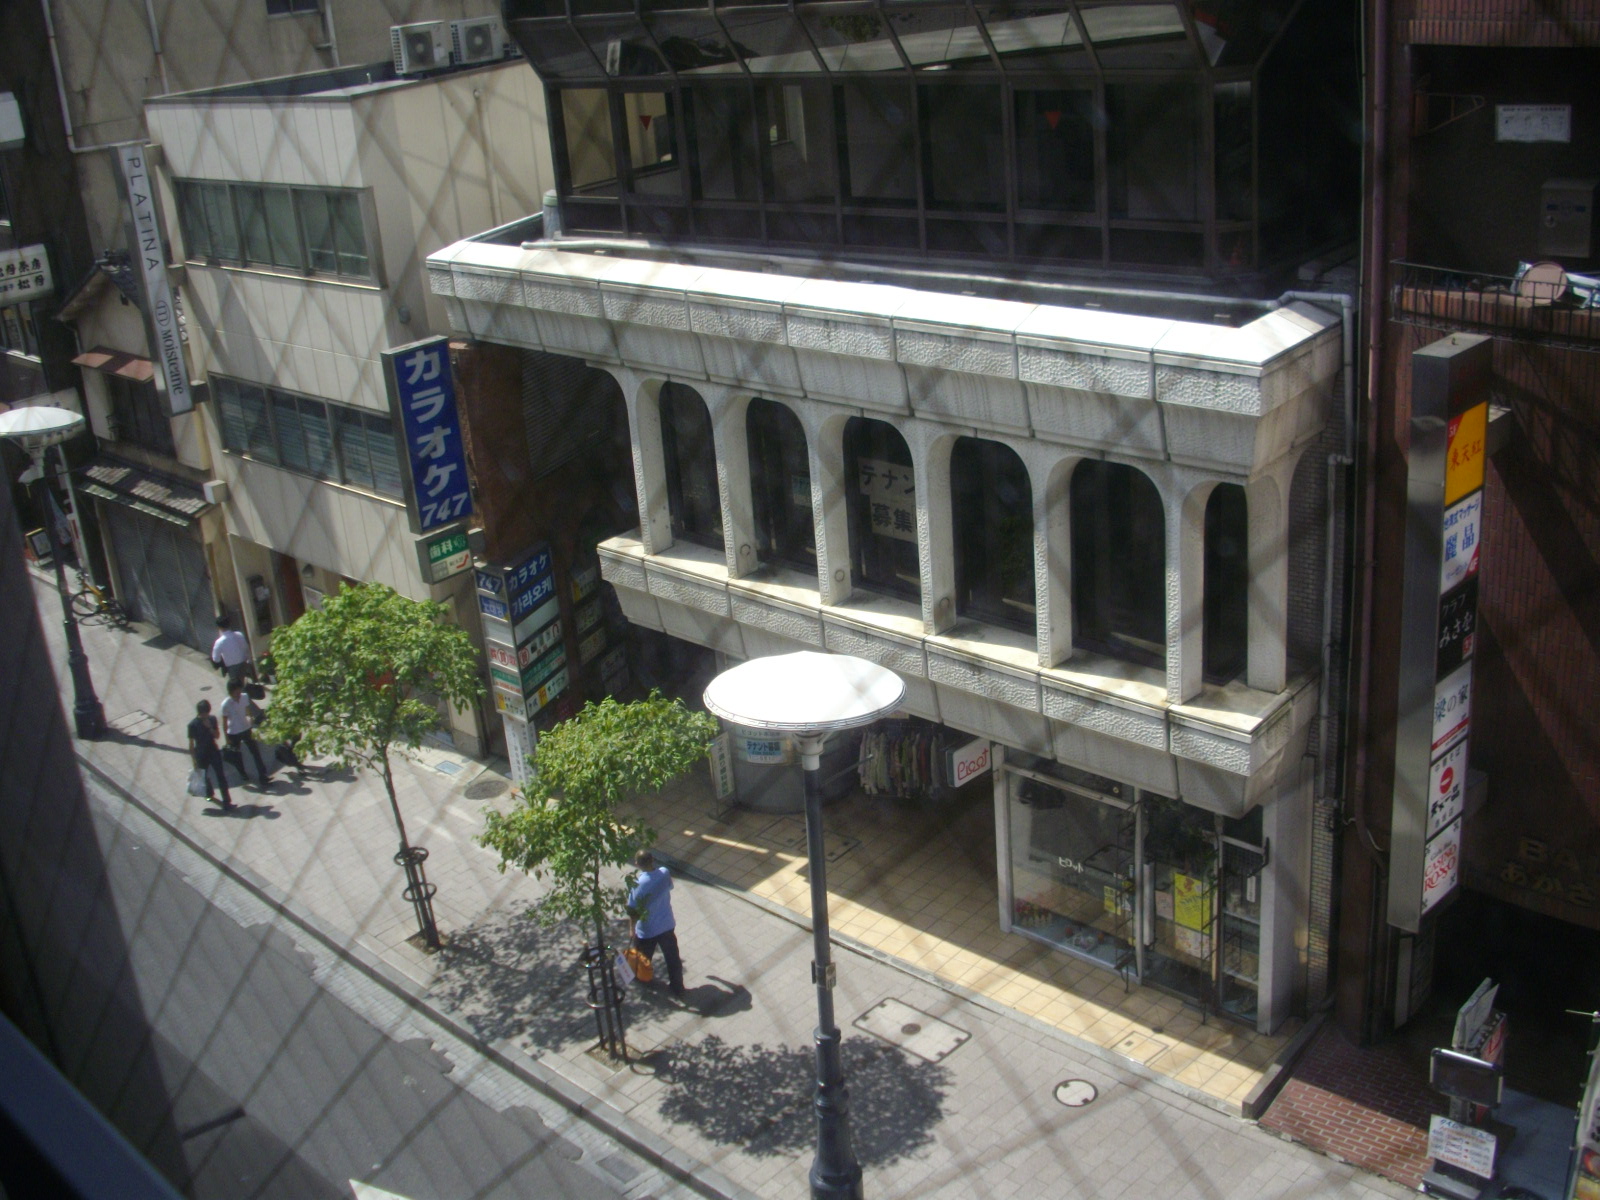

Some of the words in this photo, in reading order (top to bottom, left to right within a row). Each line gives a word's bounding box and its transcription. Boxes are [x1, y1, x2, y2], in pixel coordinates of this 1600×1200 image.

[127, 157, 159, 271] PLATINA
[161, 329, 183, 395] Moisteane
[405, 350, 457, 498] カラオケ
[1450, 440, 1482, 470] 東天紅
[861, 464, 916, 494] テナン
[422, 492, 468, 528] 747
[478, 573, 502, 592] 747
[508, 554, 547, 591] カラオケ
[511, 575, 552, 616] 가라오케
